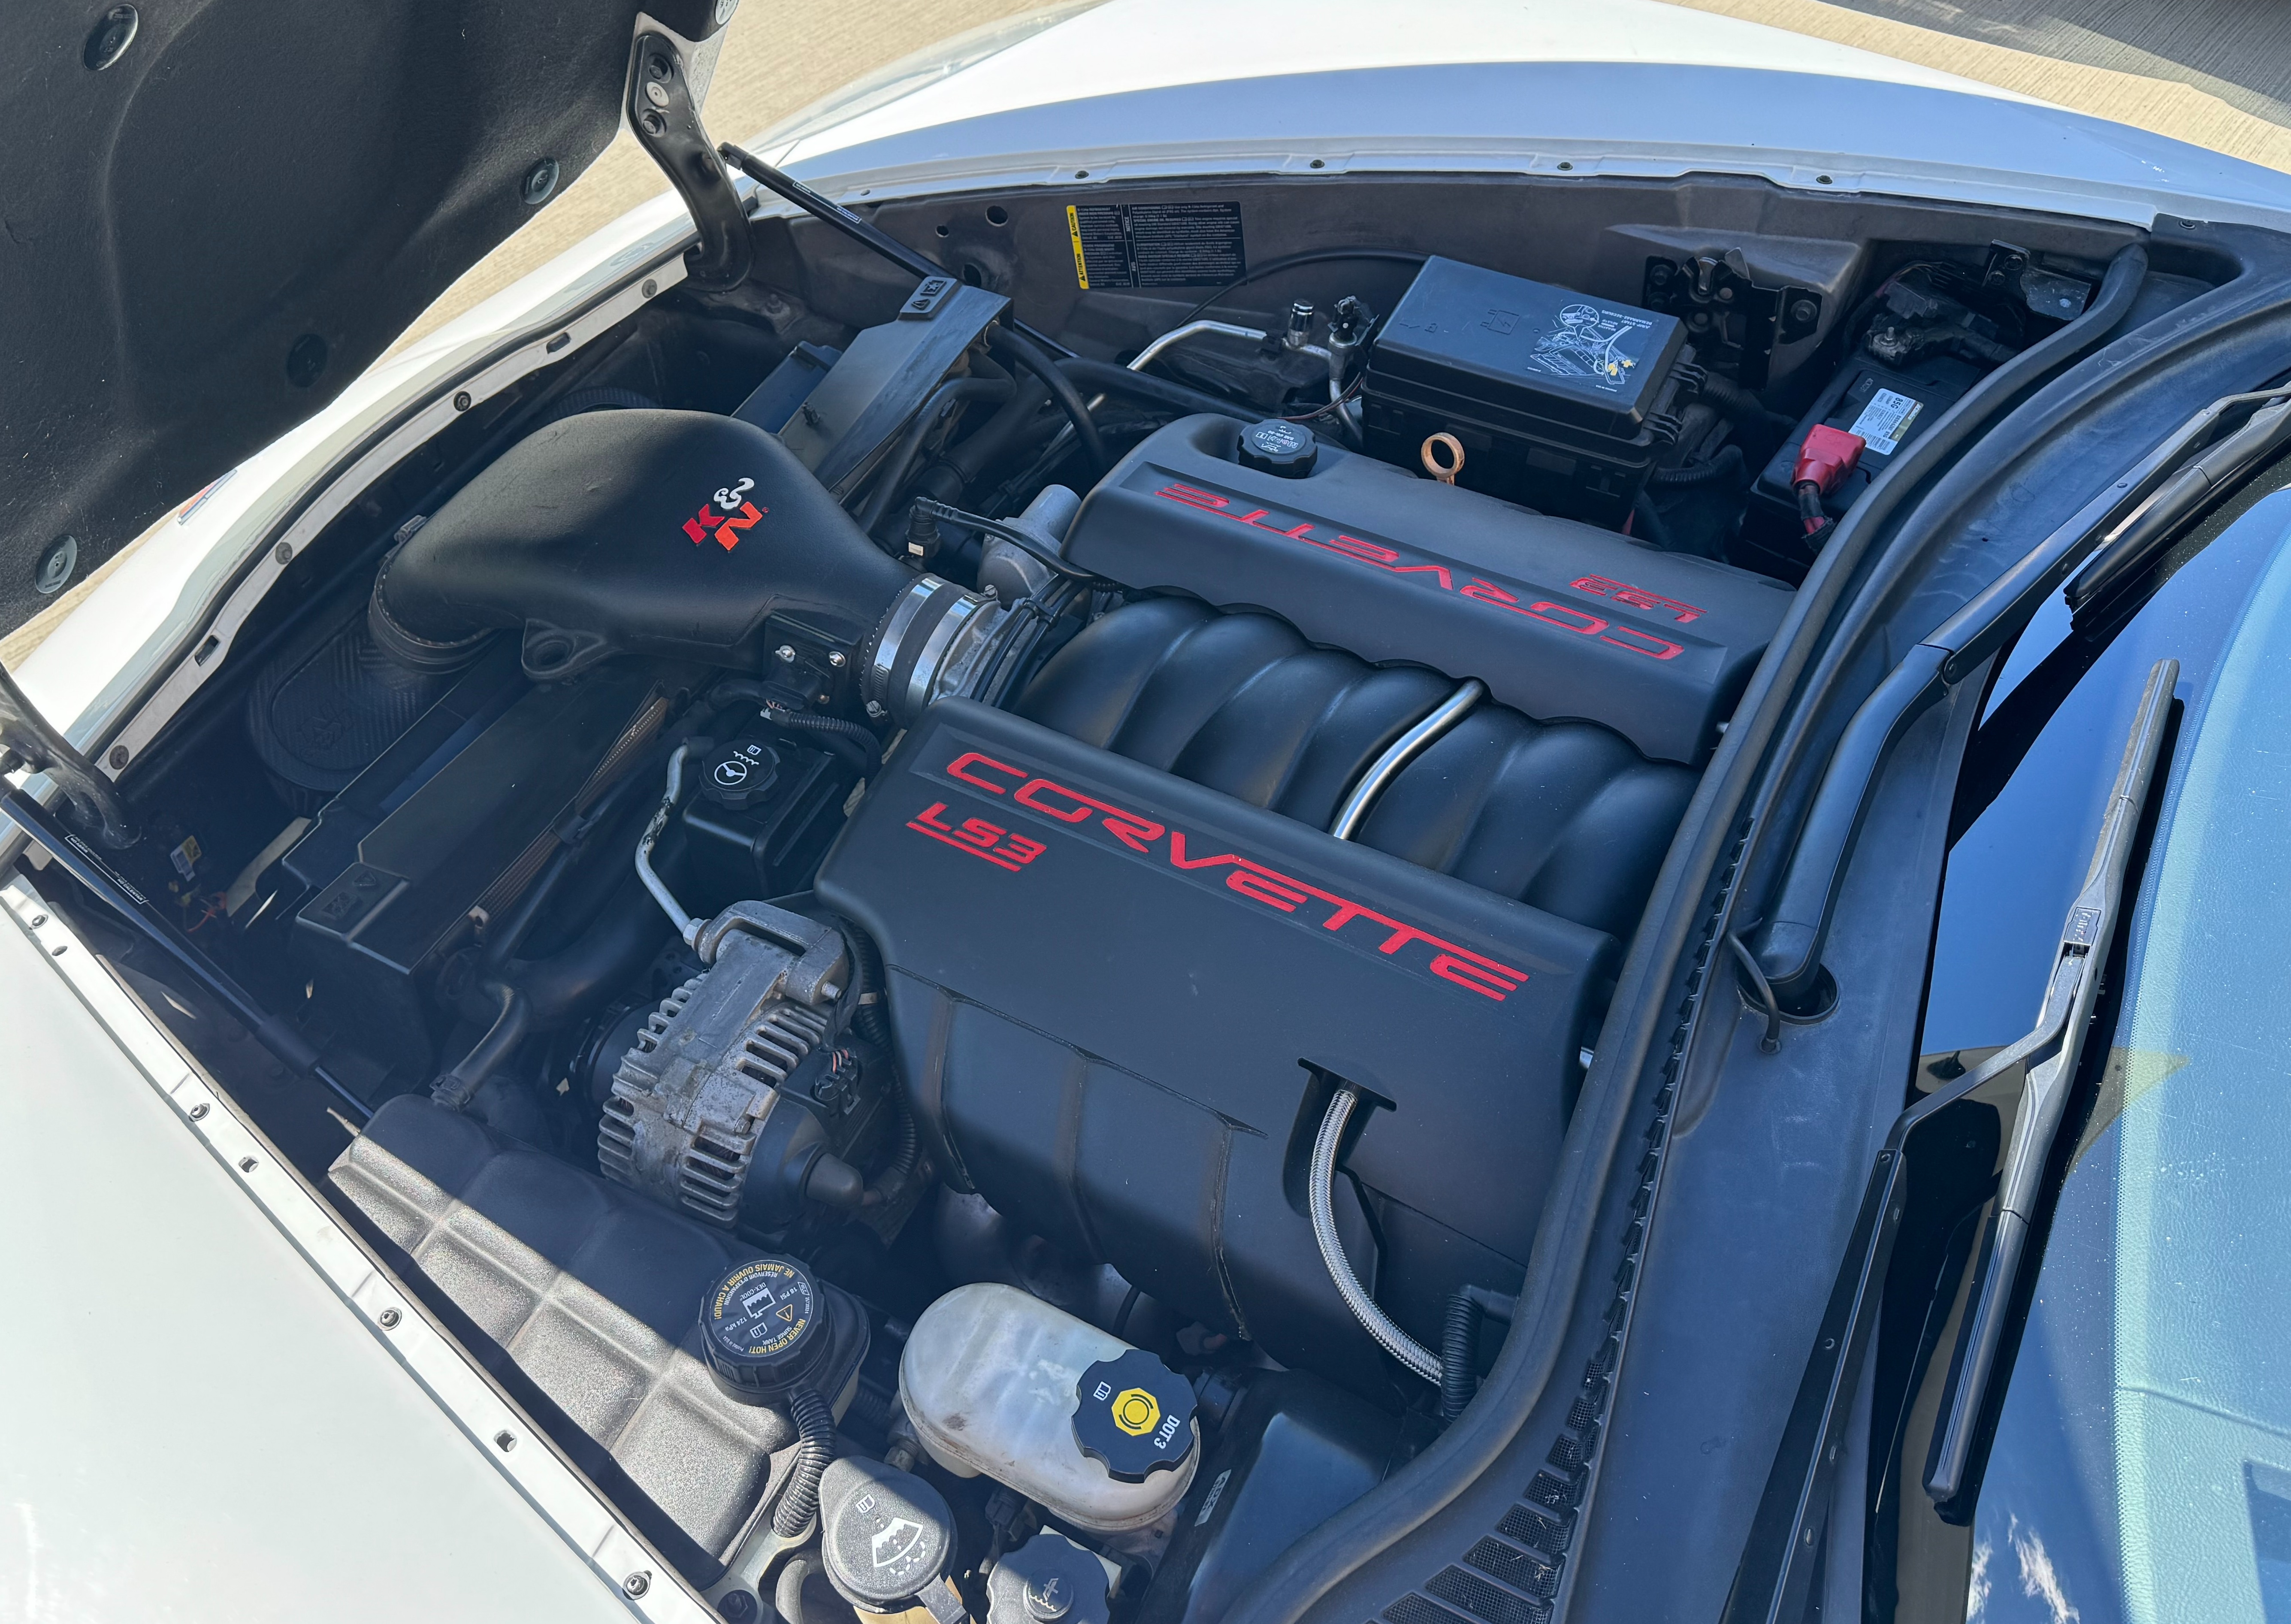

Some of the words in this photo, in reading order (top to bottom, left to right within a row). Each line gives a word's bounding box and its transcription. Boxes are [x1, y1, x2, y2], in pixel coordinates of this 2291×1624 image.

[1891, 398, 1903, 409] 85G
[682, 478, 763, 550] K&N
[1156, 483, 1685, 660] CORVETTE
[1571, 574, 1707, 623] LS3
[906, 801, 1047, 871] LS3
[946, 753, 1529, 1001] CORVETTE
[727, 1266, 753, 1286] OUVRIR
[784, 1268, 795, 1278] NE
[780, 1290, 789, 1300] PSI
[714, 1292, 725, 1319] CHAUD!
[725, 1322, 736, 1331] kPa
[777, 1326, 792, 1340] SURGE
[786, 1318, 805, 1340] NEVER
[762, 1337, 776, 1345] TANK
[768, 1338, 787, 1352] OPEN
[1160, 1415, 1180, 1442] DOT
[1154, 1437, 1167, 1449] 3
